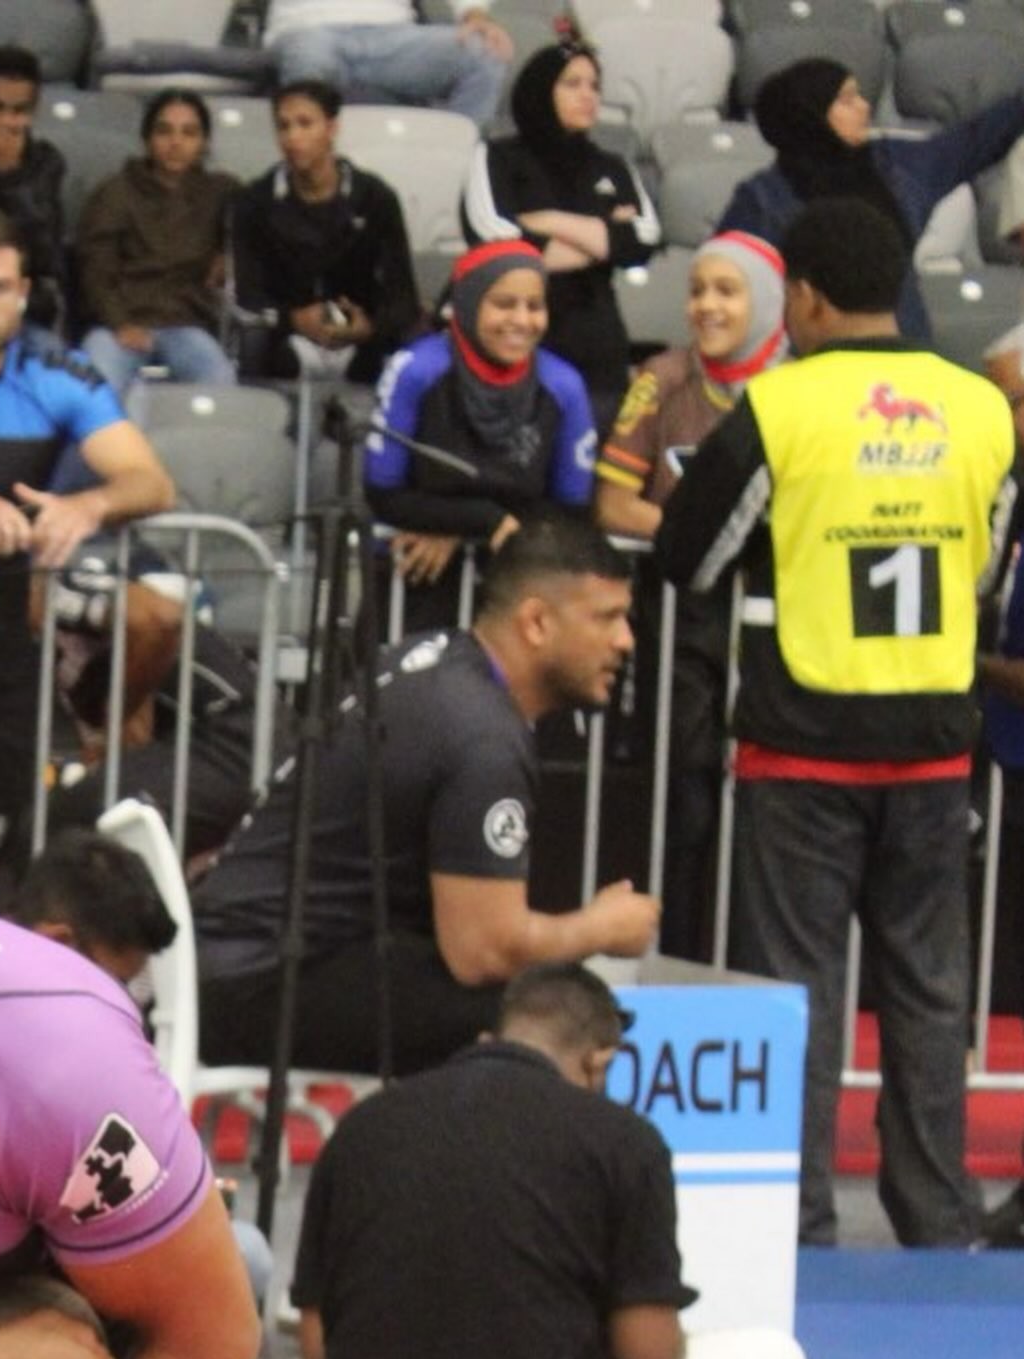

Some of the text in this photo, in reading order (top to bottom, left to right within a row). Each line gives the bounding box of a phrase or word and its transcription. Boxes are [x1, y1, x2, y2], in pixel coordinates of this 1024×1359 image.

[858, 441, 947, 466] MBJJF
[824, 524, 964, 543] COORDINATOR
[869, 545, 921, 637] 1
[604, 1039, 769, 1113] OACH
